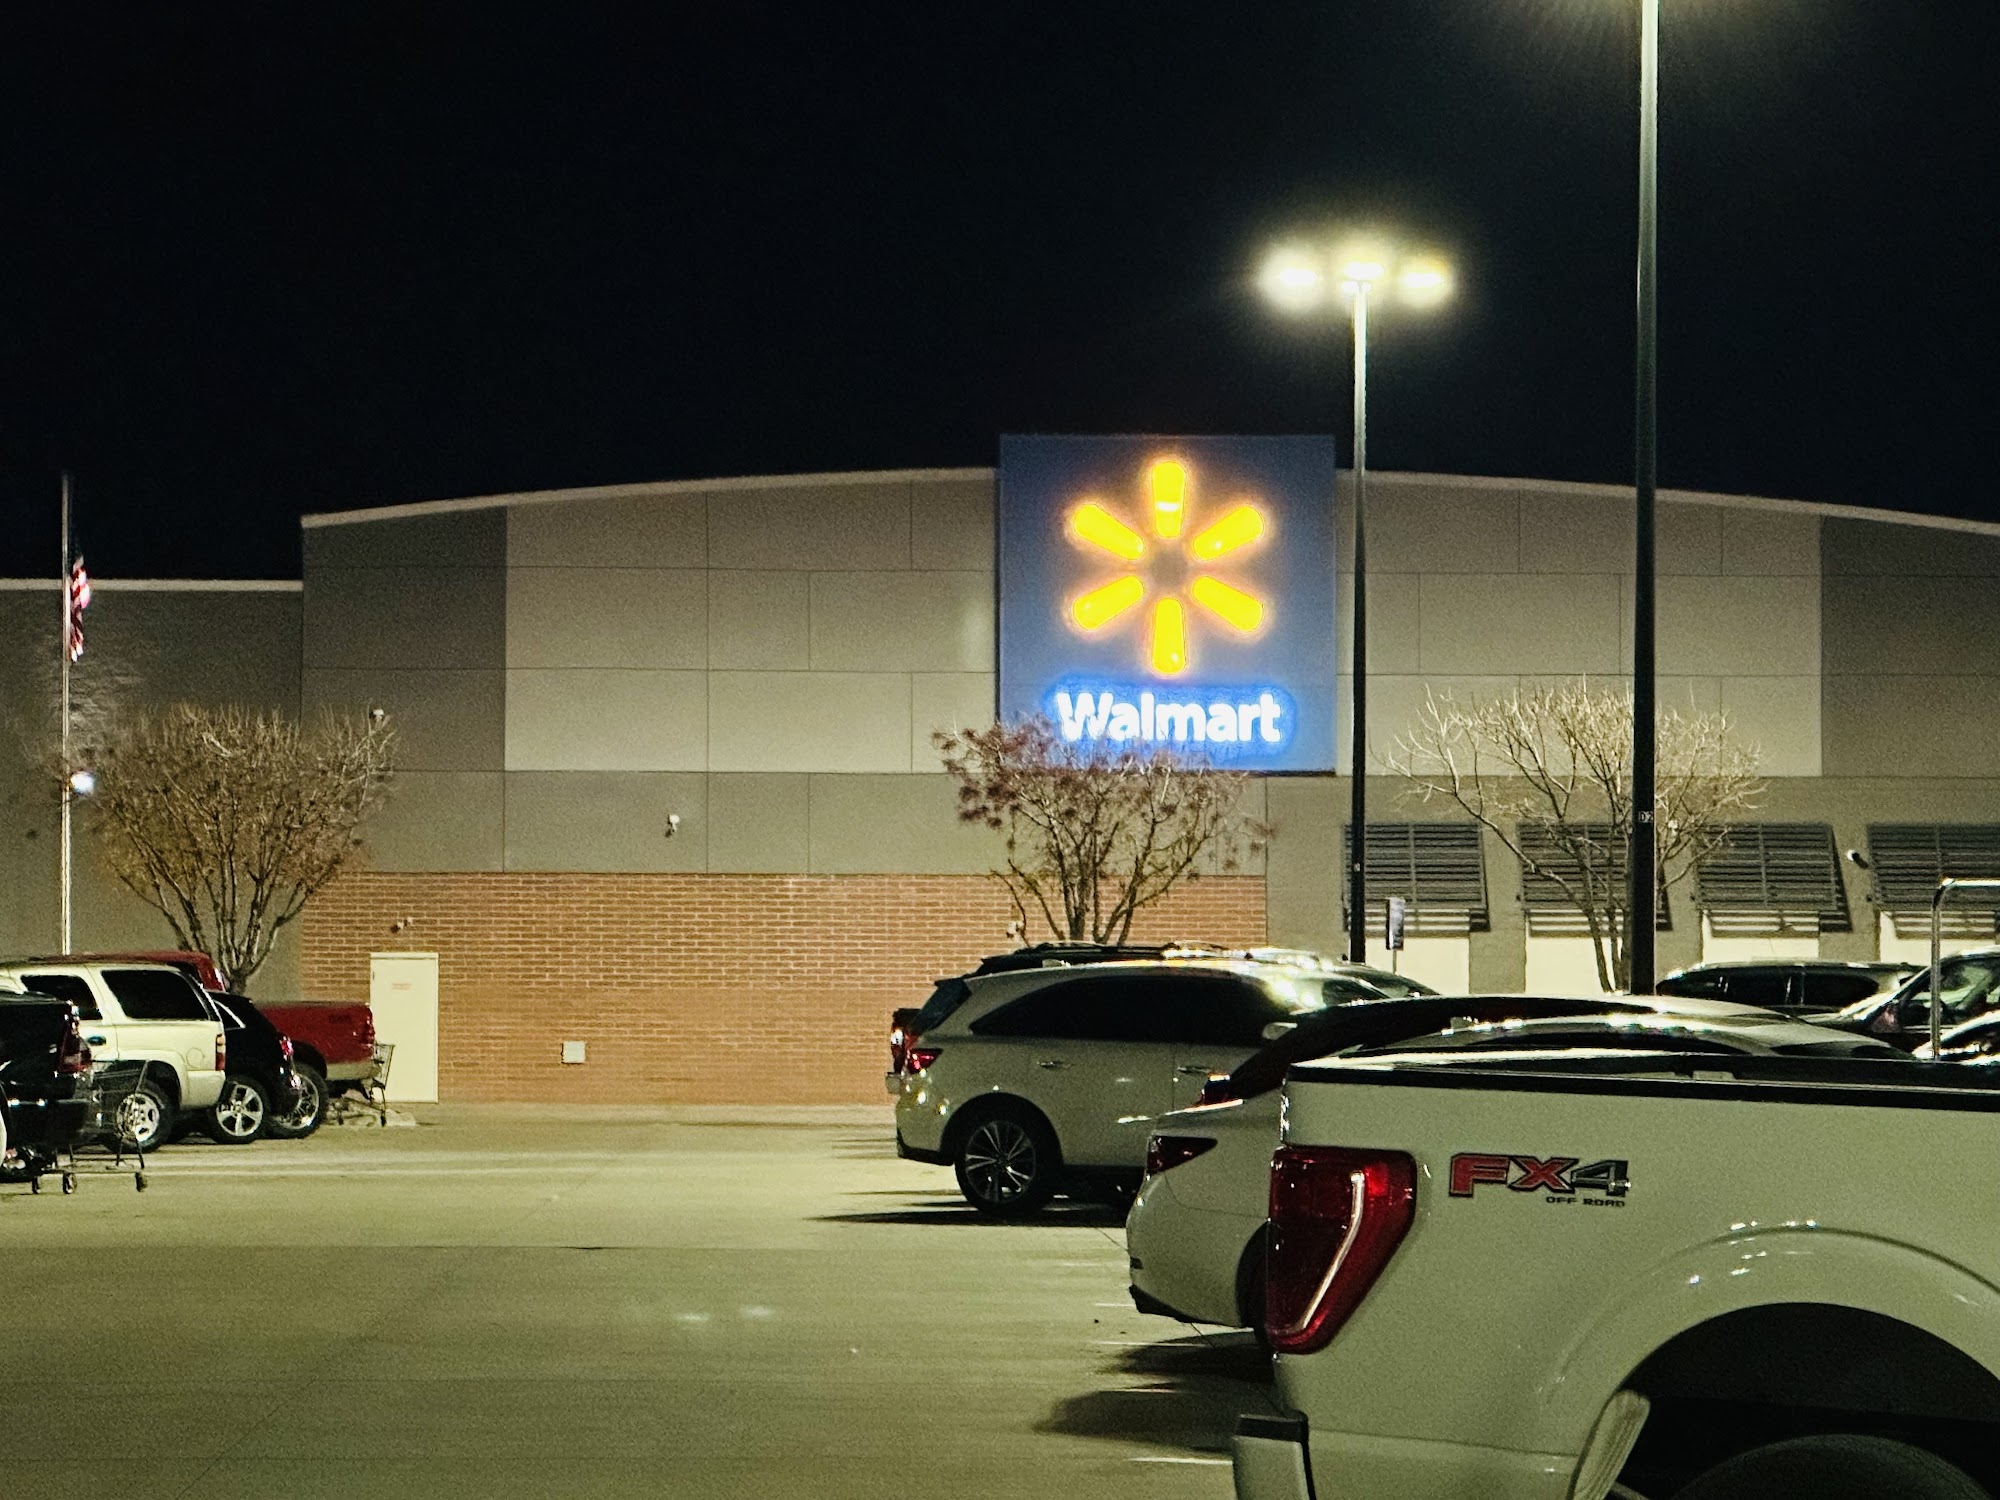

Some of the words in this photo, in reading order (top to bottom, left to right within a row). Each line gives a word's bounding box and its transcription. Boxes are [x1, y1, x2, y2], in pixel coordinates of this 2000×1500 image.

[1056, 692, 1282, 743] Walmart
[1449, 1152, 1630, 1198] FX4
[1546, 1196, 1577, 1204] OFF
[1583, 1198, 1626, 1207] ROAD
